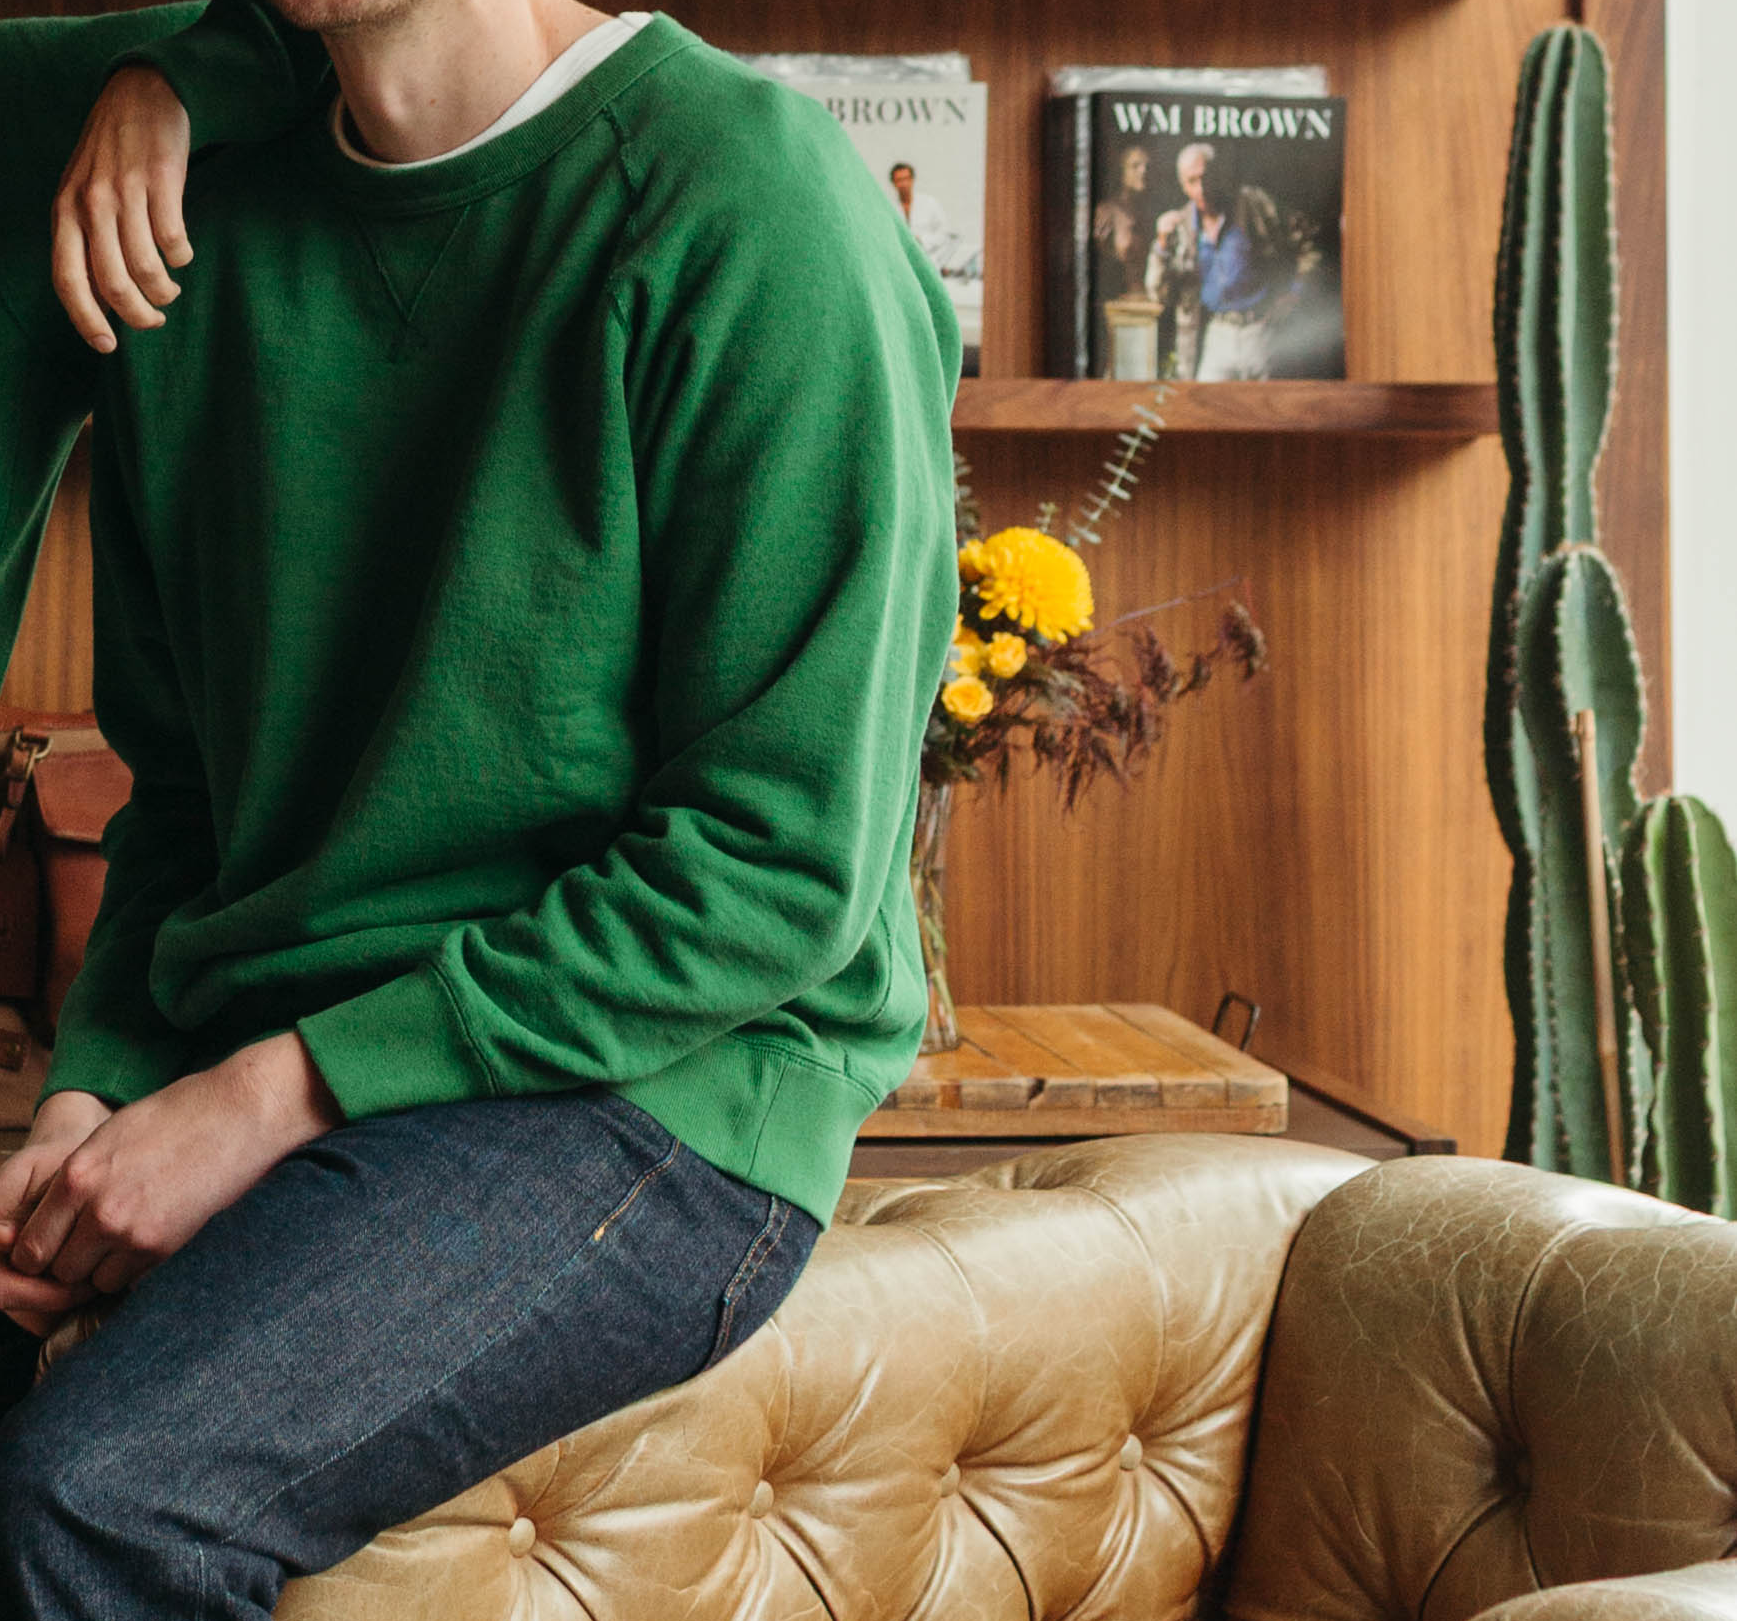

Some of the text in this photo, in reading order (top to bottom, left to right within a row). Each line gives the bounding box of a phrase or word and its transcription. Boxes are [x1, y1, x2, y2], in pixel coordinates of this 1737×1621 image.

[826, 97, 969, 124] BROWN
[1113, 102, 1332, 139] WM BROWN
